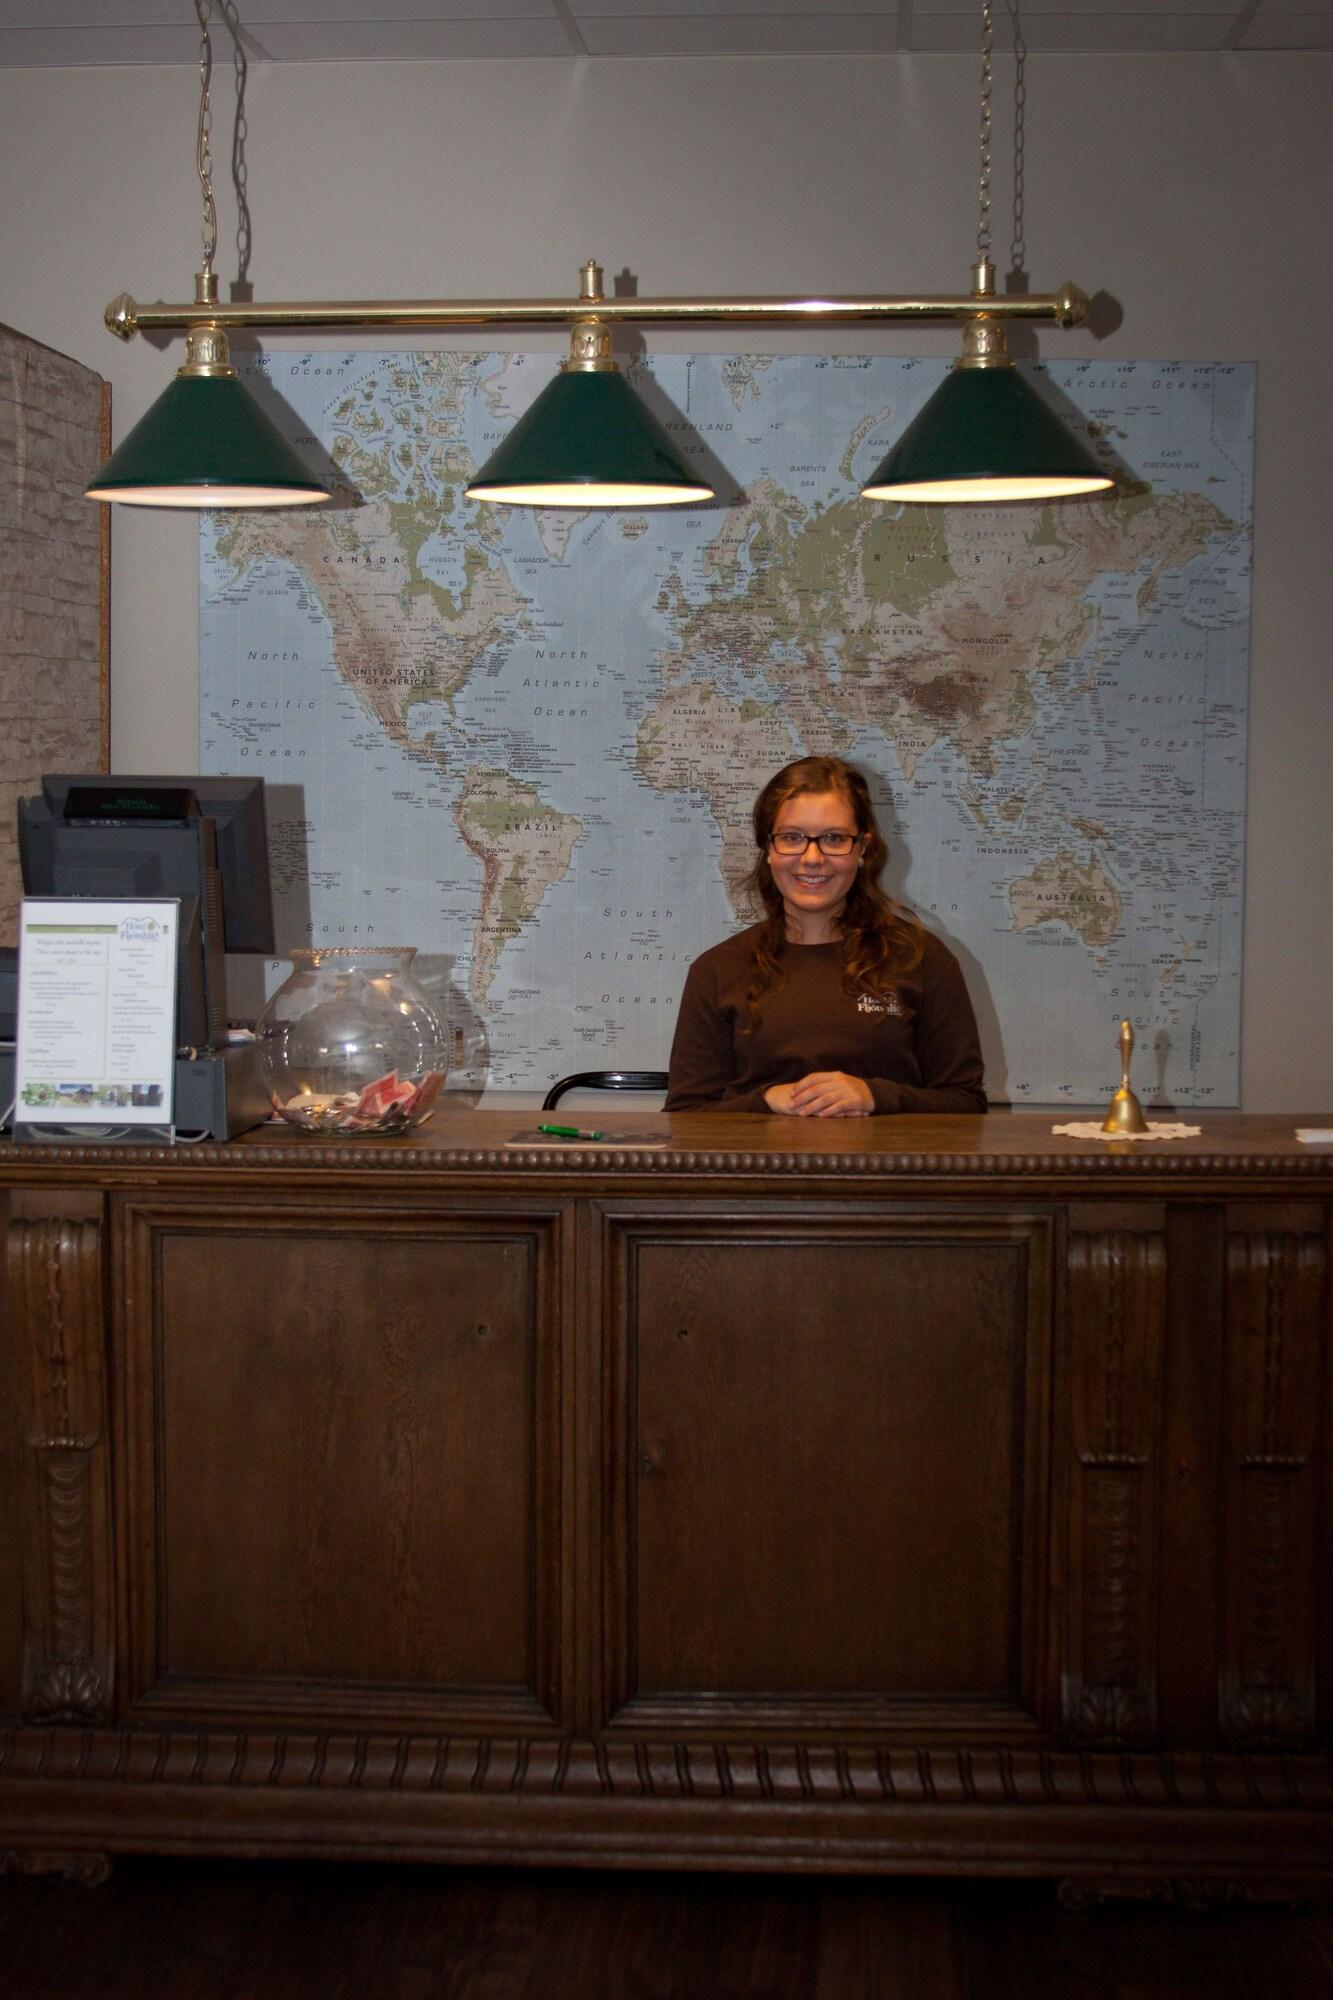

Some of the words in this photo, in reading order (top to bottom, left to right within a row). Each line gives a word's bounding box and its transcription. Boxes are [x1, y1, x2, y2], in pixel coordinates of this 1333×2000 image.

[291, 366, 345, 376] Ocean
[1063, 379, 1128, 389] Arctic
[1151, 380, 1211, 390] Ocean
[323, 556, 400, 564] CANADA
[874, 553, 1046, 564] RUSSIA
[248, 650, 300, 661] North
[535, 650, 588, 660] North
[1143, 650, 1204, 660] North
[396, 669, 435, 677] STATES
[365, 678, 379, 686] OF
[381, 678, 429, 686] AMERICA
[522, 678, 601, 689] Atlantic
[231, 699, 316, 710] Pacific
[1127, 693, 1207, 705] Pacific
[533, 706, 589, 717] Ocean
[1139, 737, 1204, 748] Ocean
[240, 747, 307, 758] Ocean
[504, 823, 558, 831] BRAZIL
[977, 847, 1030, 855] INDONESIA
[1036, 894, 1106, 902] AUSTRALIA
[603, 907, 673, 918] South
[305, 923, 375, 933] South
[584, 951, 692, 962] Atlantic
[1110, 988, 1182, 998] South
[601, 994, 673, 1005] Ocean
